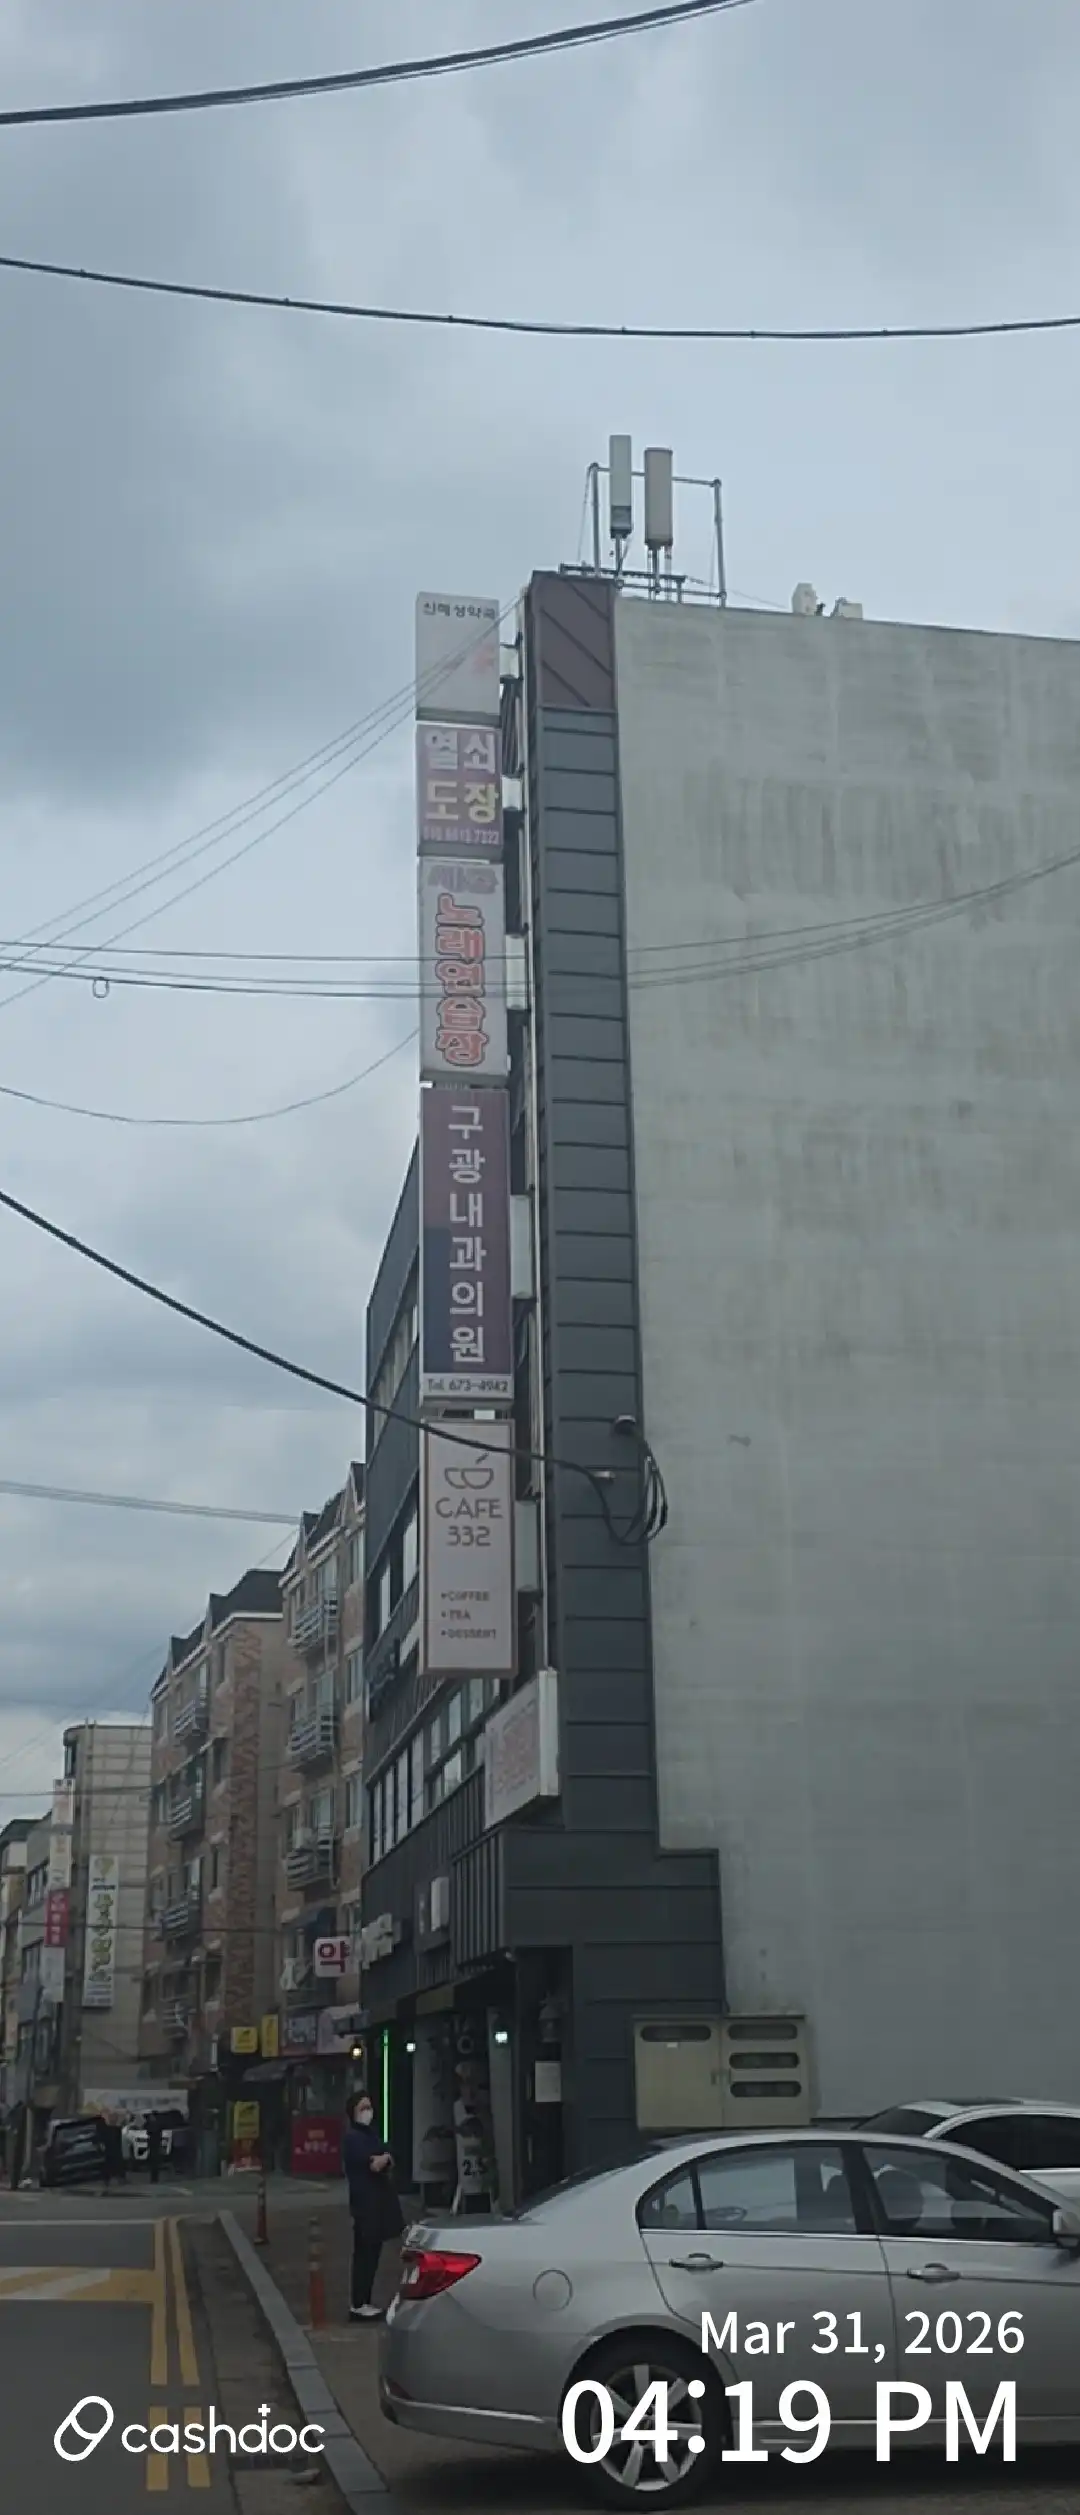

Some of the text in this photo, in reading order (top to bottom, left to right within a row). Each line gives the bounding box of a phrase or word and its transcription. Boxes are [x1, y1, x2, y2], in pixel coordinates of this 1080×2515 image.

[424, 730, 496, 774] 열쇠
[425, 779, 499, 824] 도장
[435, 892, 489, 1067] 노래연습장
[448, 1105, 487, 1363] 구광내과의원
[435, 1497, 504, 1519] CAFE
[447, 1526, 492, 1547] 332
[448, 1590, 490, 1602] COFFEE
[449, 1609, 472, 1621] TEA
[318, 1941, 349, 1974] 약
